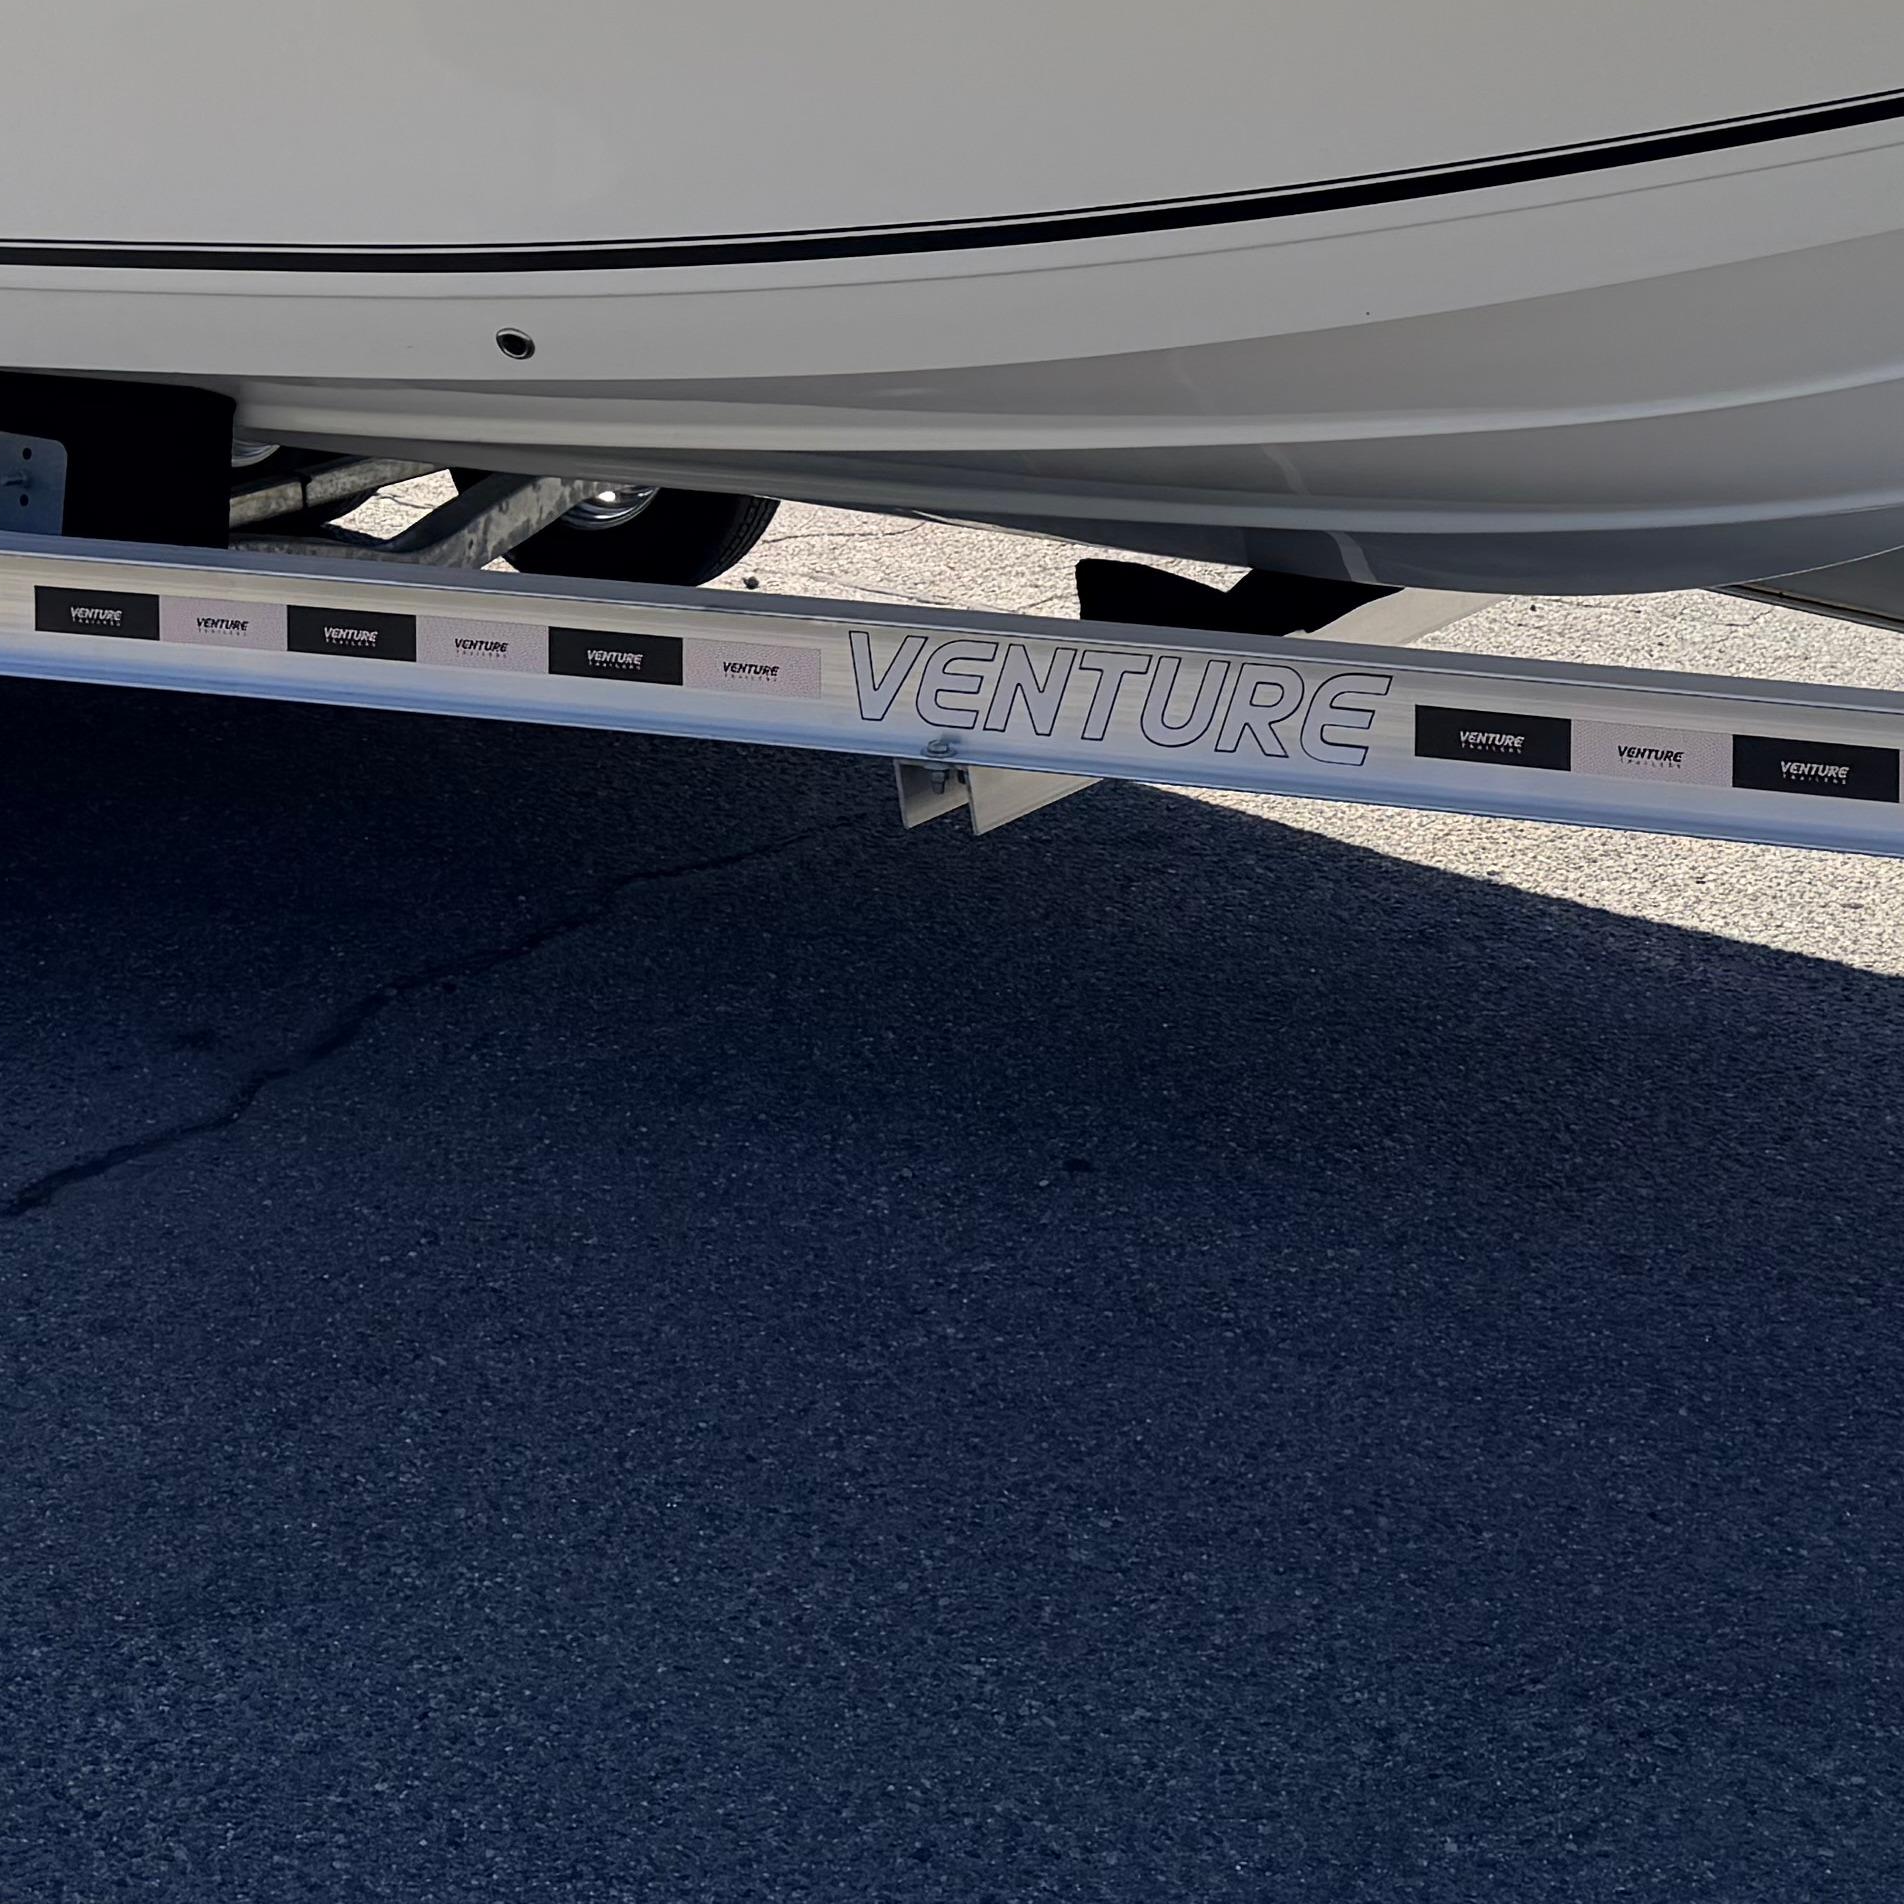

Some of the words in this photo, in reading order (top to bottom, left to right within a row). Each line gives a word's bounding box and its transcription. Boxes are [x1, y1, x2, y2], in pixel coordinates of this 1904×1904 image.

[70, 606, 123, 621] VENTURE
[197, 617, 249, 632] VENTURE
[324, 626, 379, 642] VENTURE
[454, 638, 509, 653] VENTURE
[586, 649, 644, 665] VENTURE
[722, 661, 780, 677] VENTURE
[848, 629, 1394, 767] VENTURE
[1459, 730, 1525, 748] VENTURE
[1617, 745, 1684, 763] VENTURE
[1780, 760, 1850, 779] VENTURE
